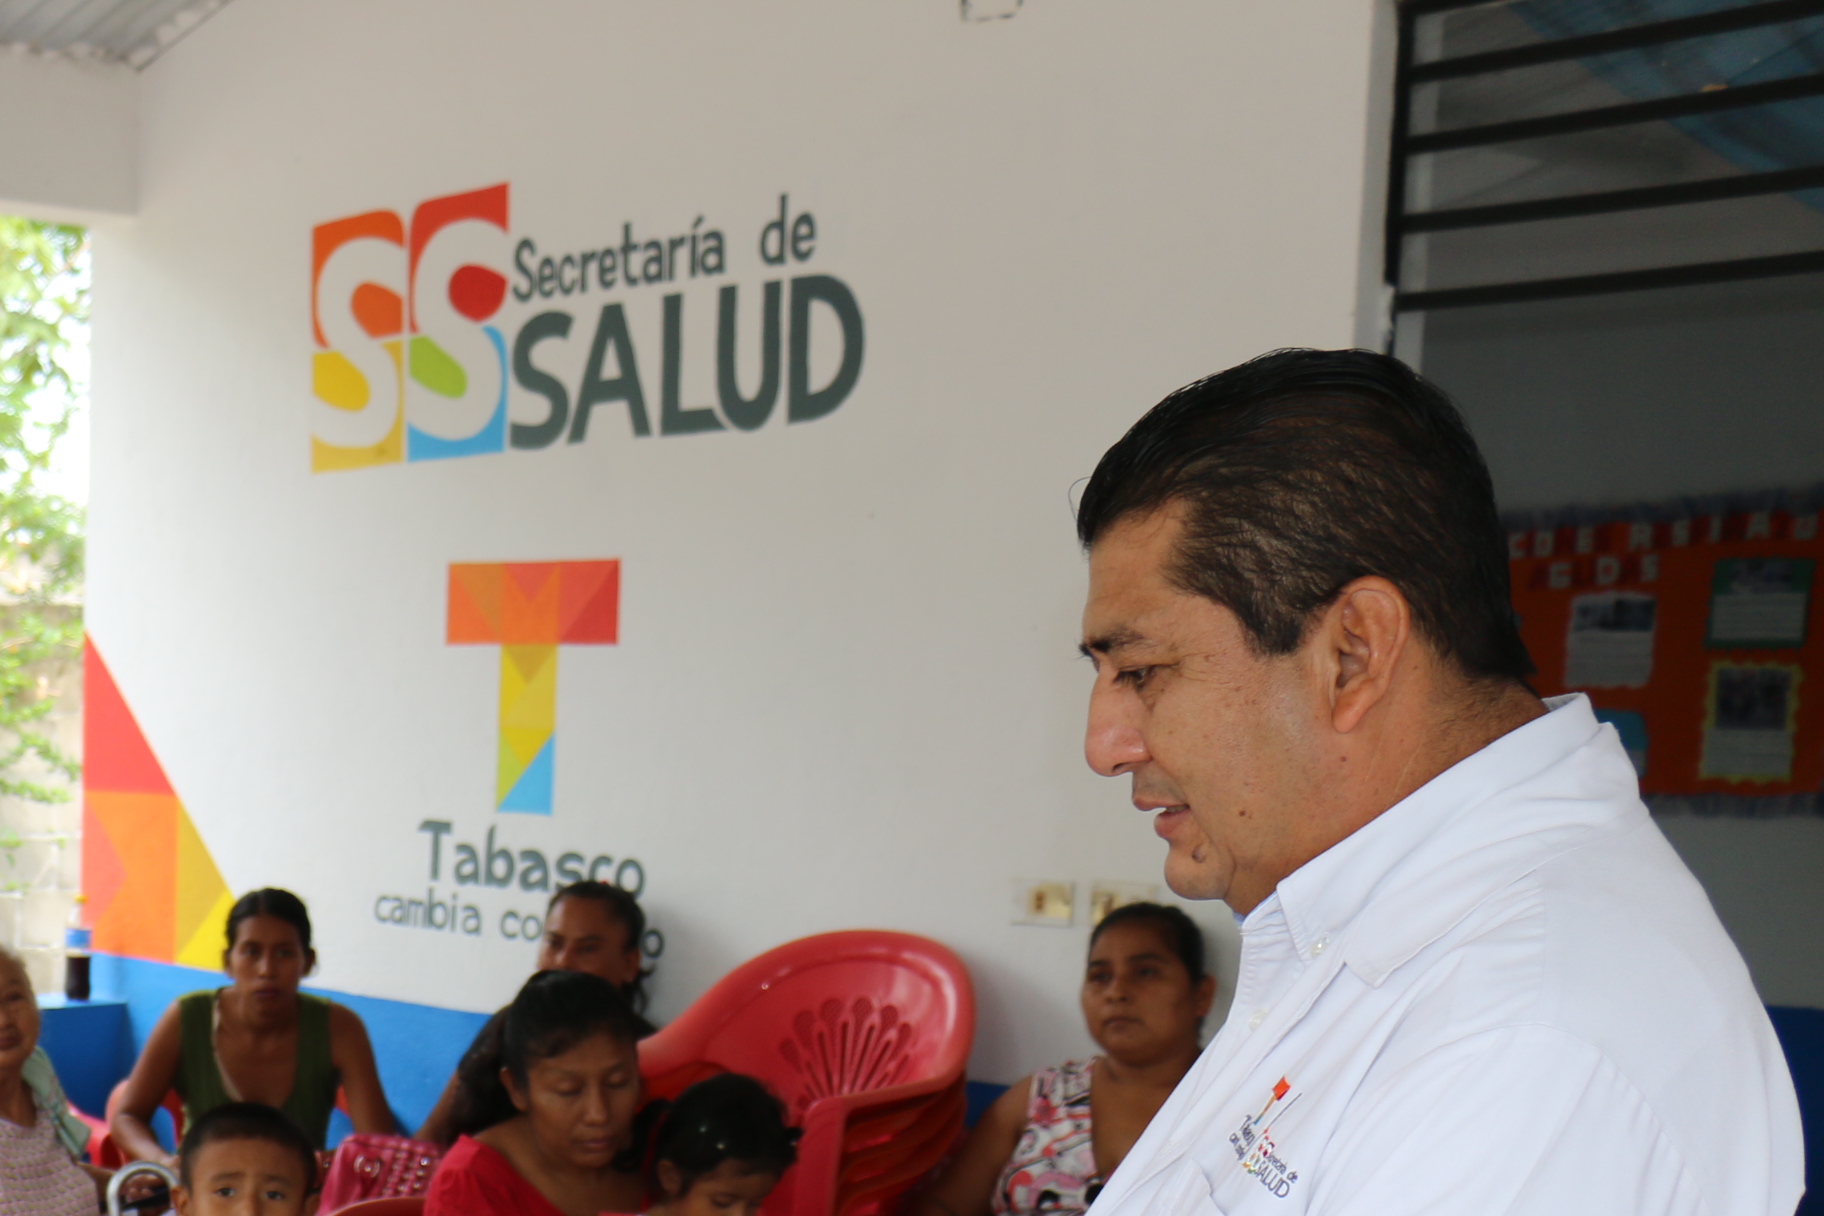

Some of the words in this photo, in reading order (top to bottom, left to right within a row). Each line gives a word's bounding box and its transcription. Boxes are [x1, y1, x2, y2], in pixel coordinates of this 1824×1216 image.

[513, 215, 726, 303] Secretaría
[759, 193, 816, 268] de
[509, 273, 865, 451] SALUD
[418, 819, 646, 903] Tabasco
[375, 887, 482, 936] cambia
[1254, 1160, 1290, 1198] SALUD
